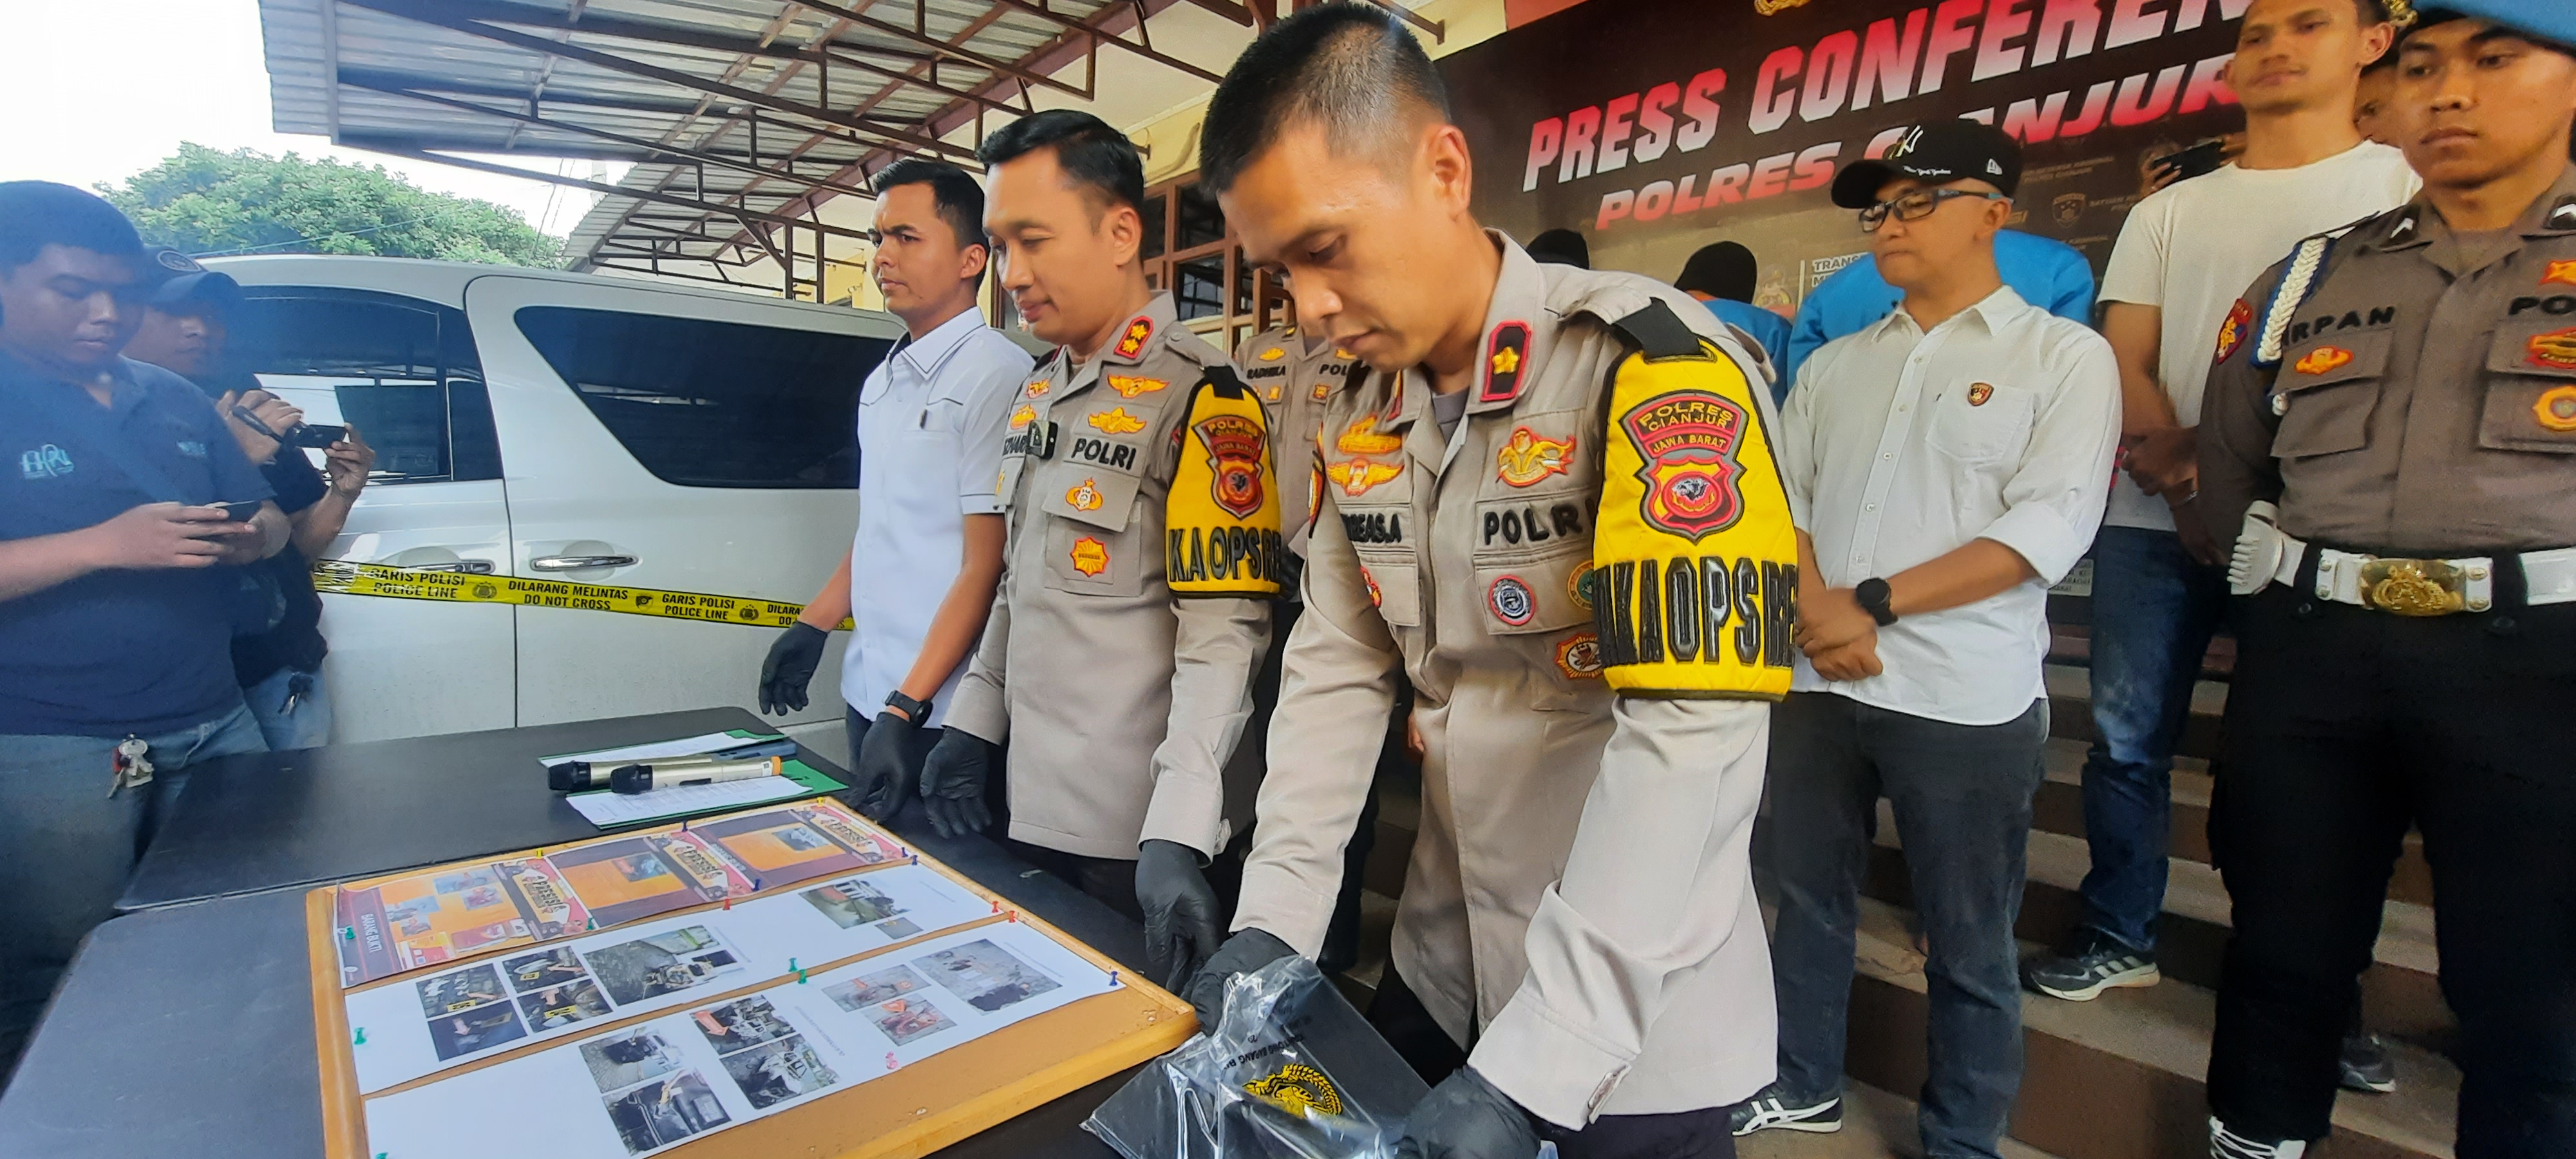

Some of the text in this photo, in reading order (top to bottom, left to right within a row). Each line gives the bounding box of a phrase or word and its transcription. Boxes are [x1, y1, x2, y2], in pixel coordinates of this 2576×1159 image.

[1522, 68, 1728, 193] PRESS
[1595, 141, 1842, 231] POLRES
[1638, 402, 1734, 427] POLRES
[1648, 413, 1728, 432] CIANJUR
[1653, 433, 1727, 453] JAWA BARAT
[1071, 438, 1137, 471] POLRI
[420, 572, 466, 586] POLISI
[374, 582, 459, 599] POLICE LINE
[508, 580, 629, 600] DILARANG MELINTAS
[523, 594, 612, 610] DO NOT CROSS
[661, 593, 736, 610] GARIS POLISI
[664, 605, 730, 621] POLICE LINE
